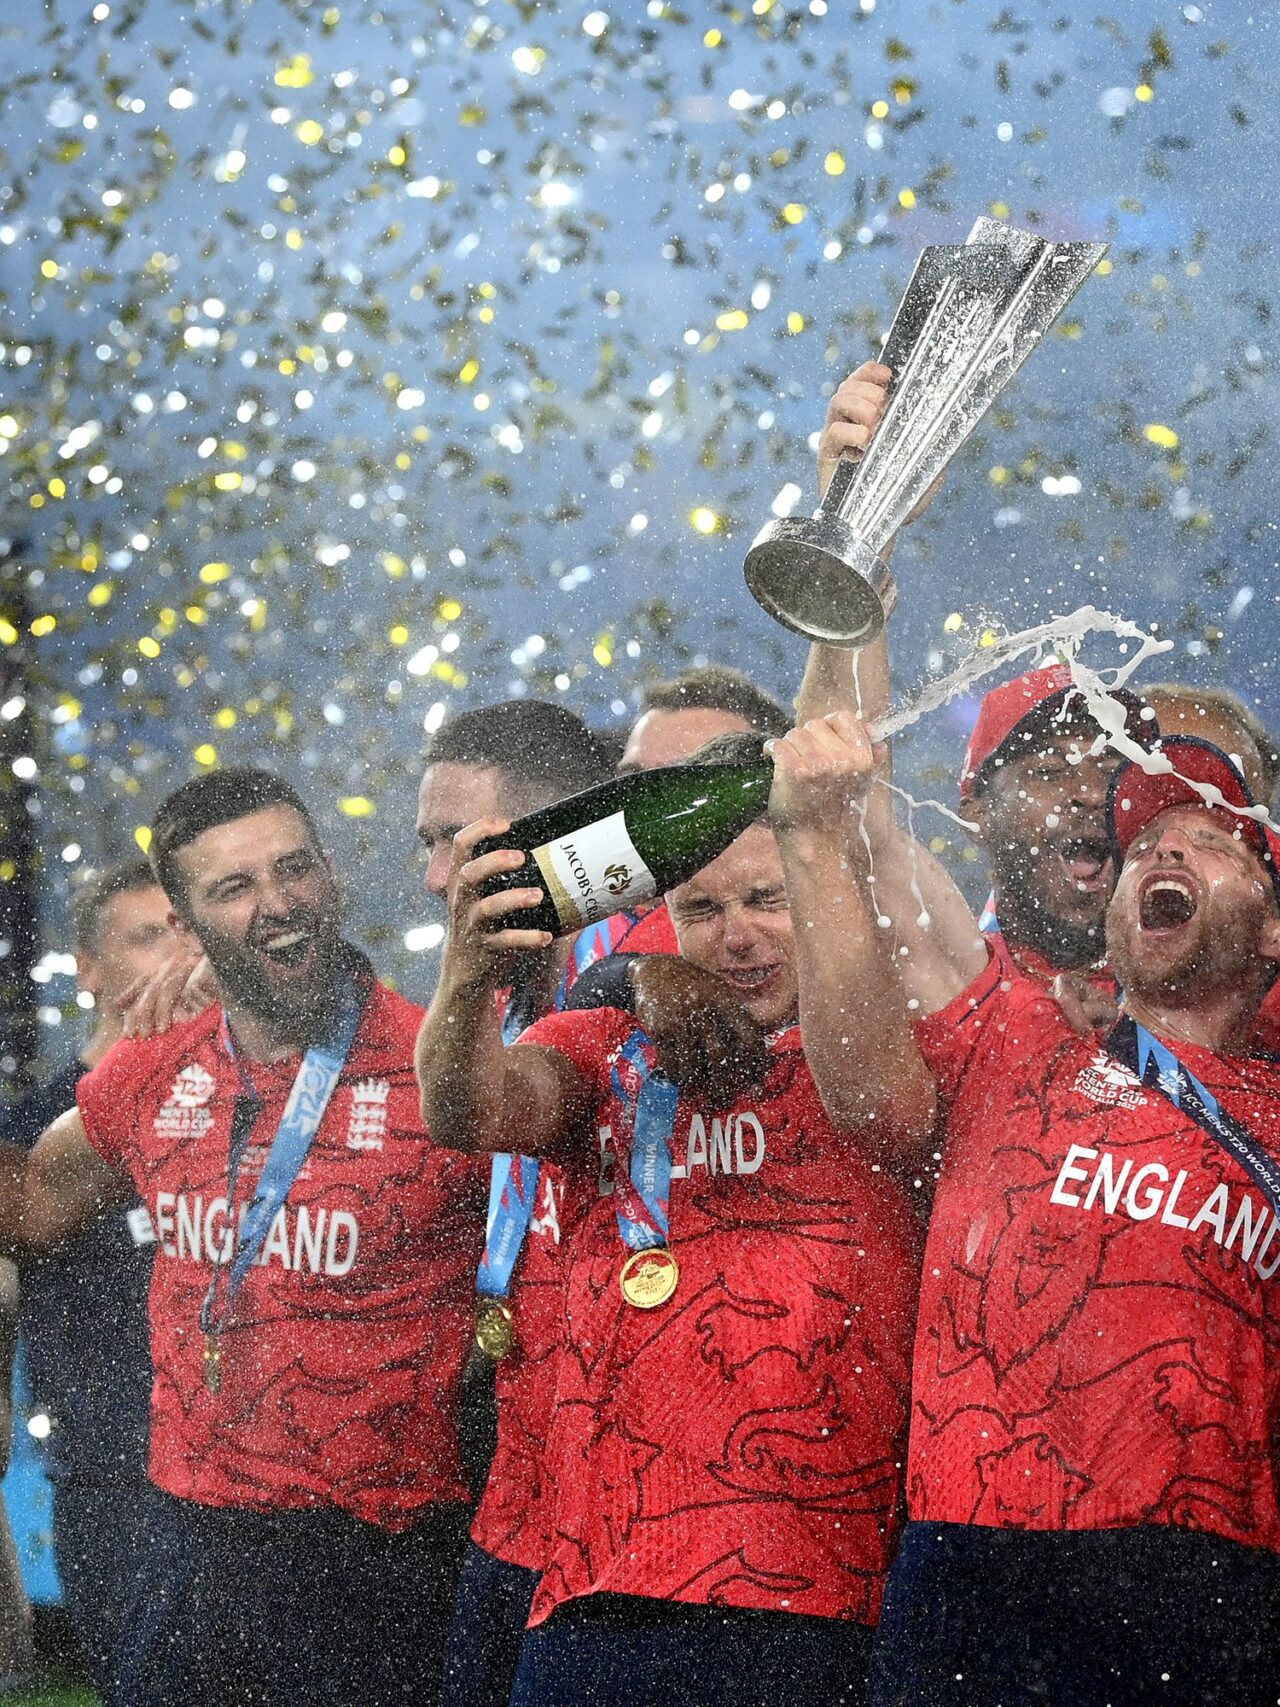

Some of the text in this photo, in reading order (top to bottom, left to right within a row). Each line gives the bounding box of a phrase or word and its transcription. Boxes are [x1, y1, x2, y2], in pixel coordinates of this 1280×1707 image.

[560, 844, 594, 897] JACOB'S
[1118, 1092, 1148, 1106] CUP
[1182, 1093, 1204, 1108] ICC
[1228, 1136, 1249, 1153] T20
[1246, 1153, 1280, 1193] WORLD
